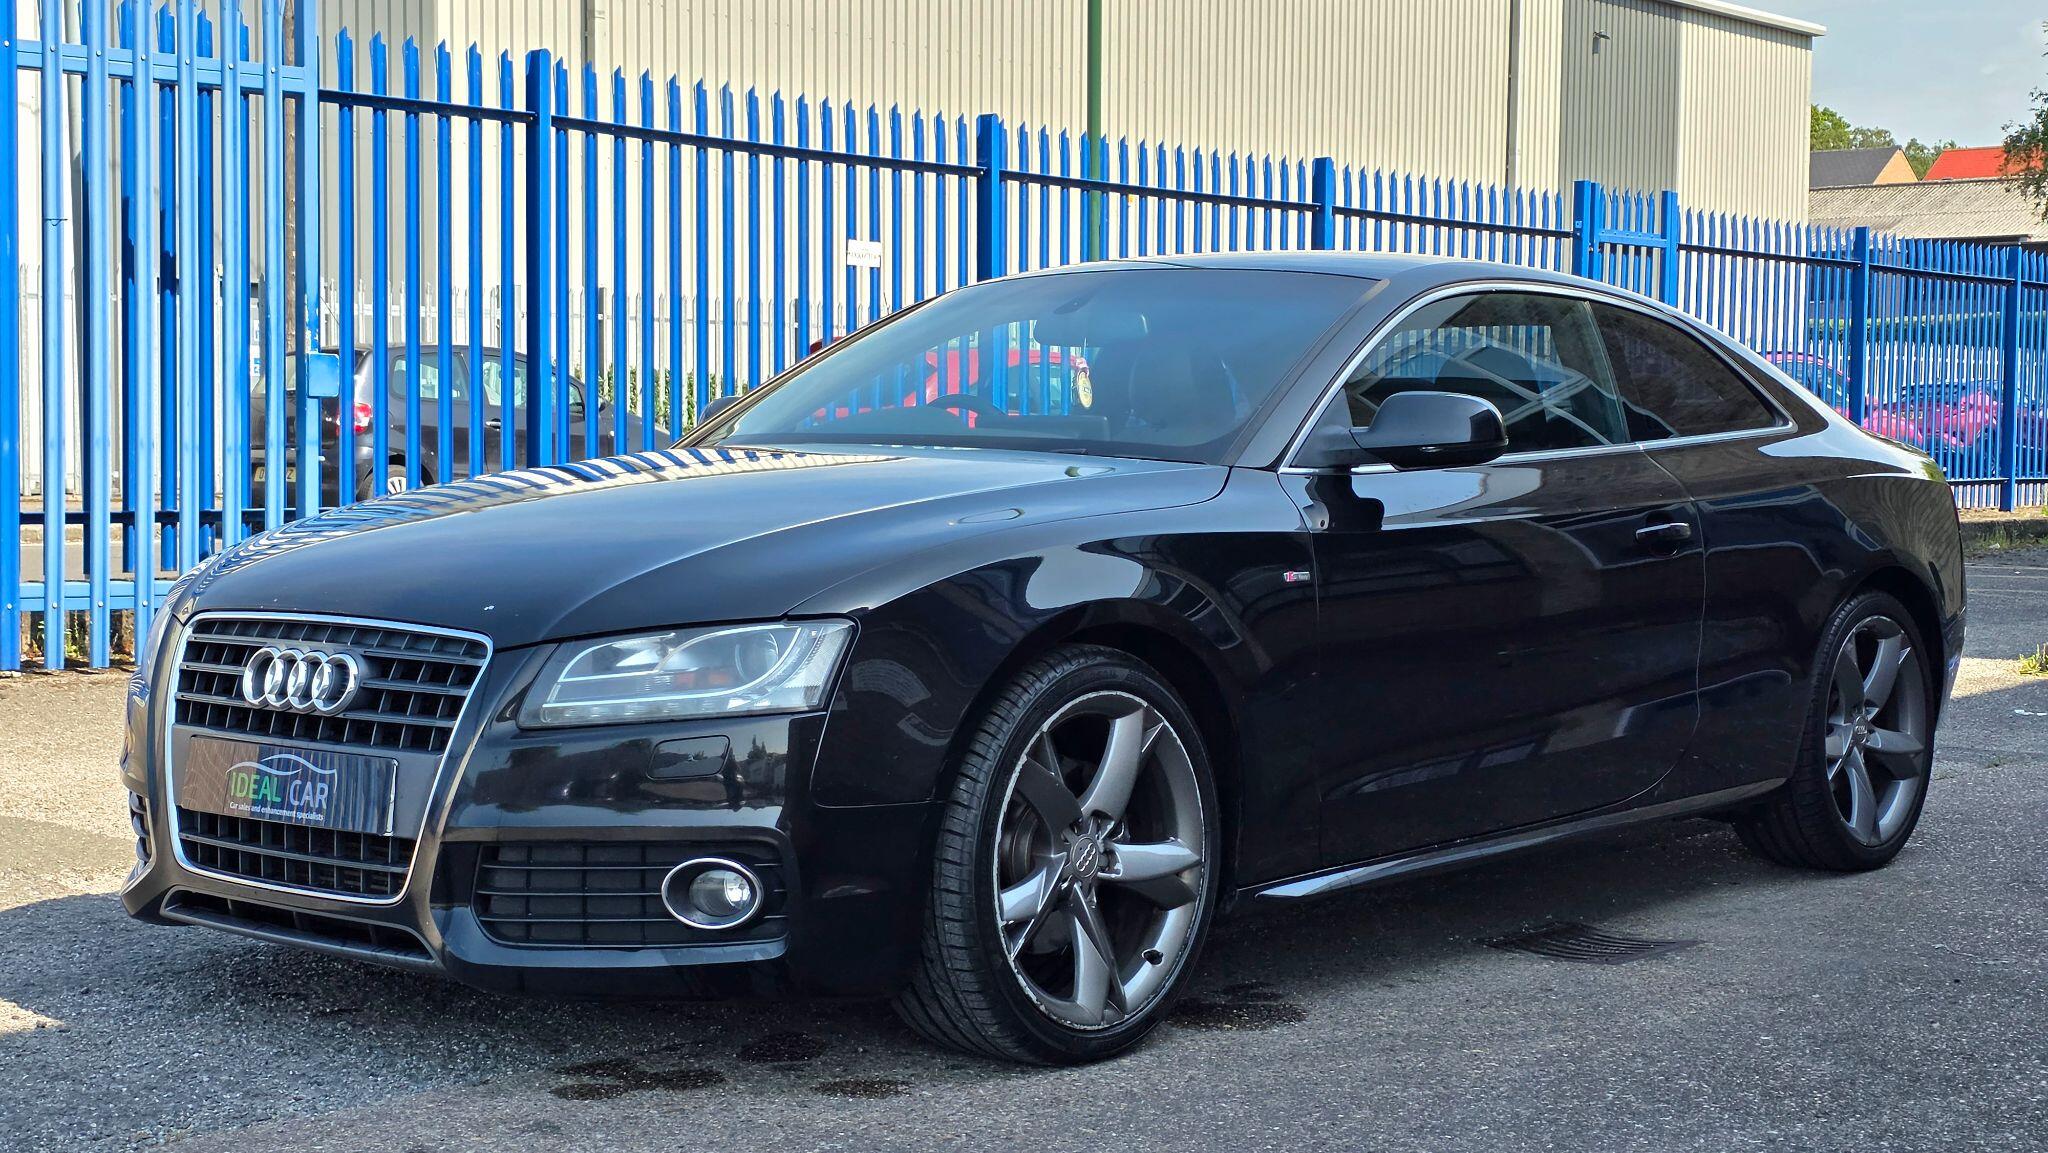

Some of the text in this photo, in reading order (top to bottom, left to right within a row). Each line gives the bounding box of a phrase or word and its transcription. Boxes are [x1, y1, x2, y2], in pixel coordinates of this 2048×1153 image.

[230, 772, 329, 810] IDEAL CAR
[229, 801, 325, 820] Car sales and enhancement specialists
